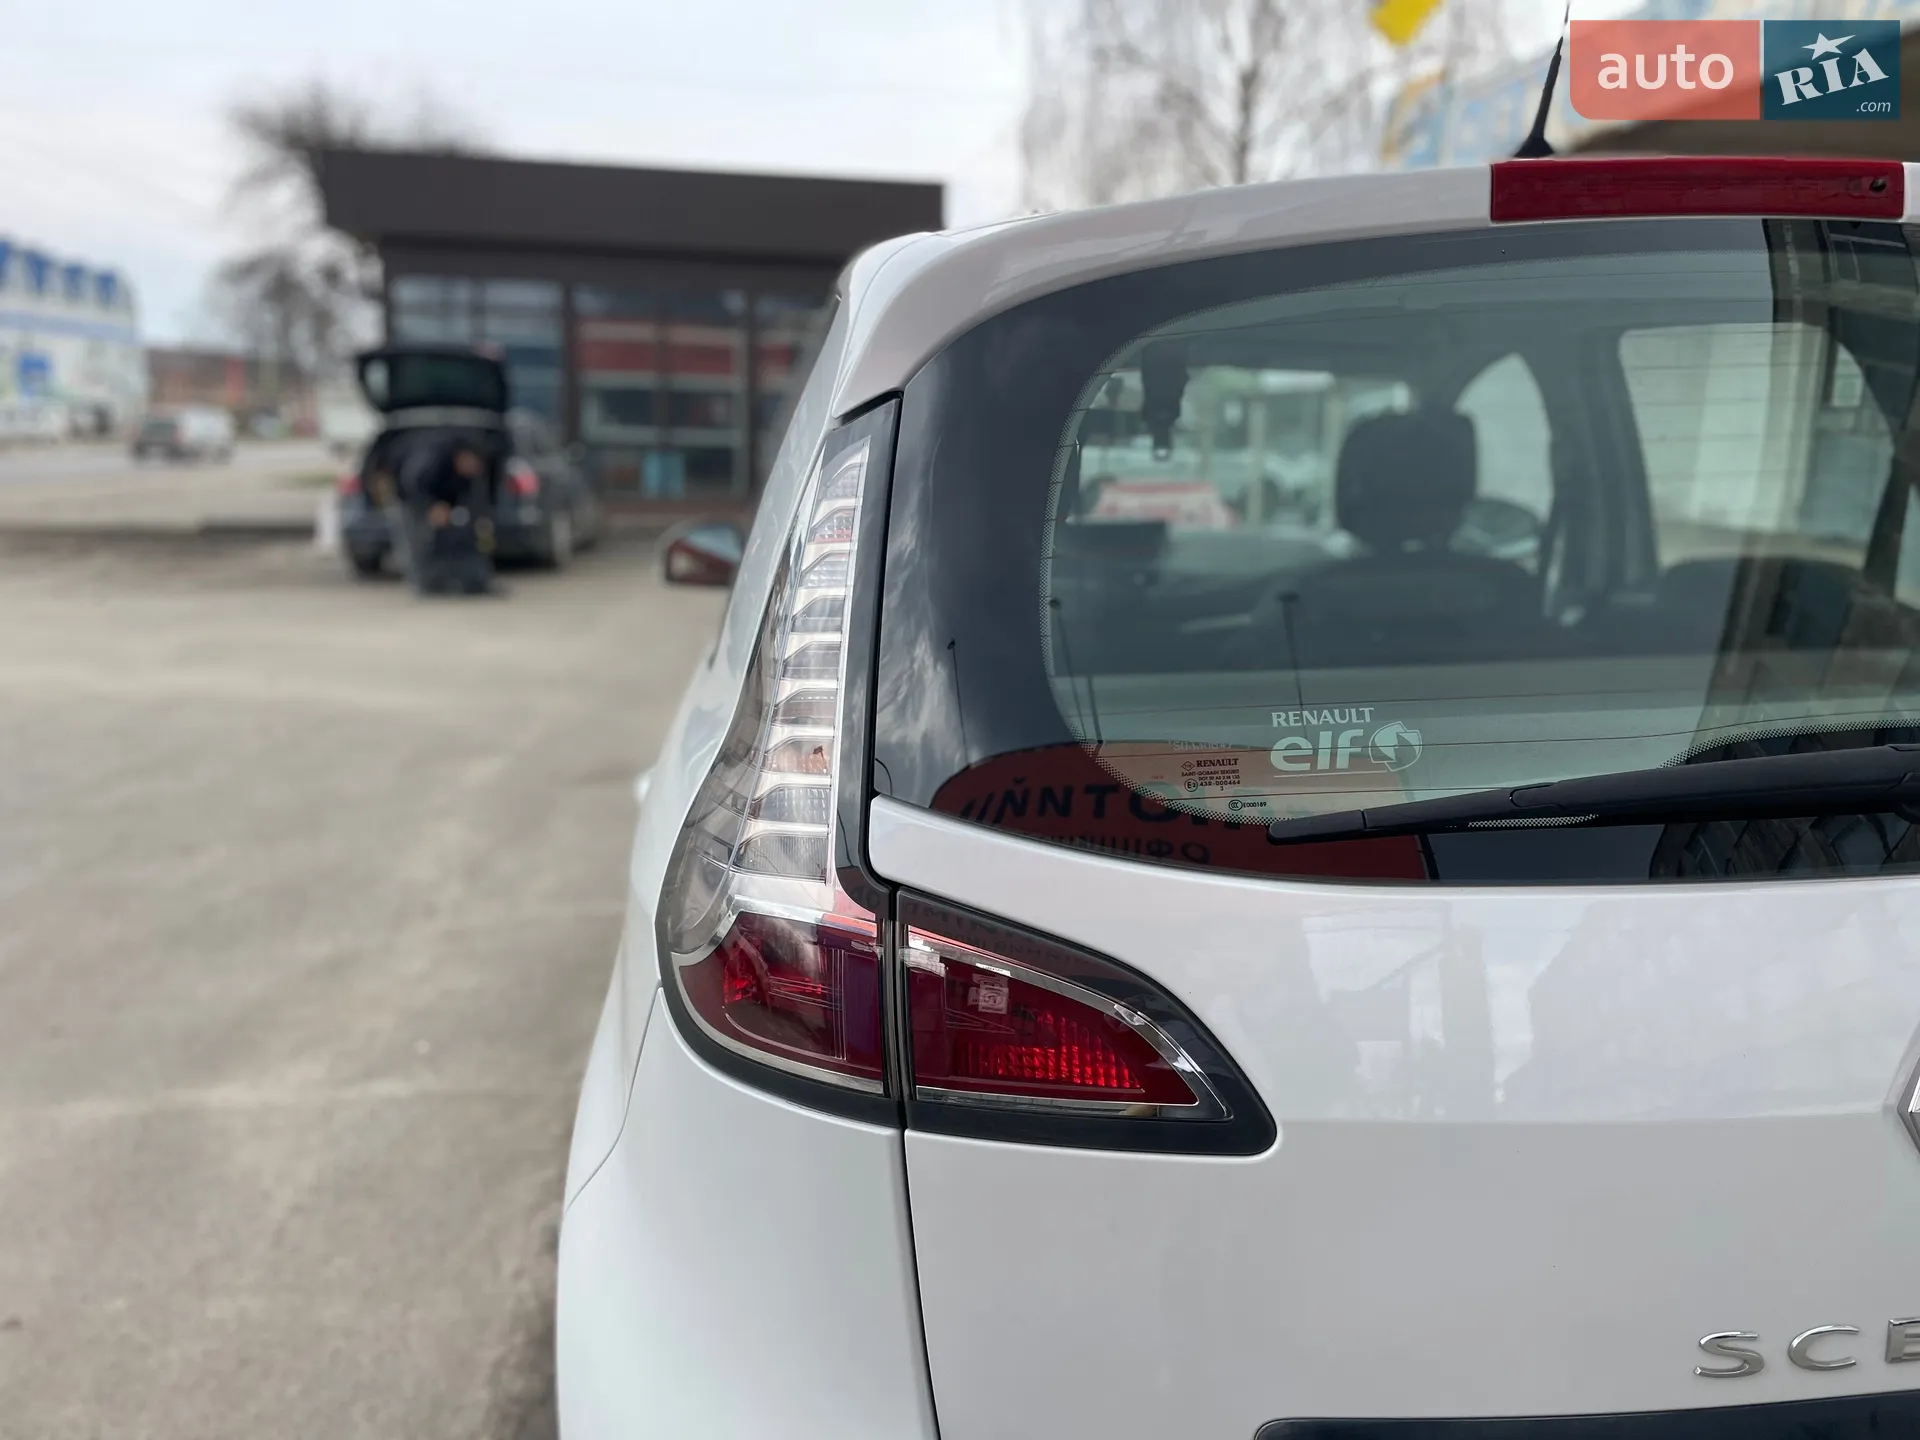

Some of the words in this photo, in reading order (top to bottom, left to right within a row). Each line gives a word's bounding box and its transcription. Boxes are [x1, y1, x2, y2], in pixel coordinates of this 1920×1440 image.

[1271, 707, 1374, 727] RENAULT
[1270, 729, 1364, 771] elf
[1196, 758, 1239, 767] RENAULT
